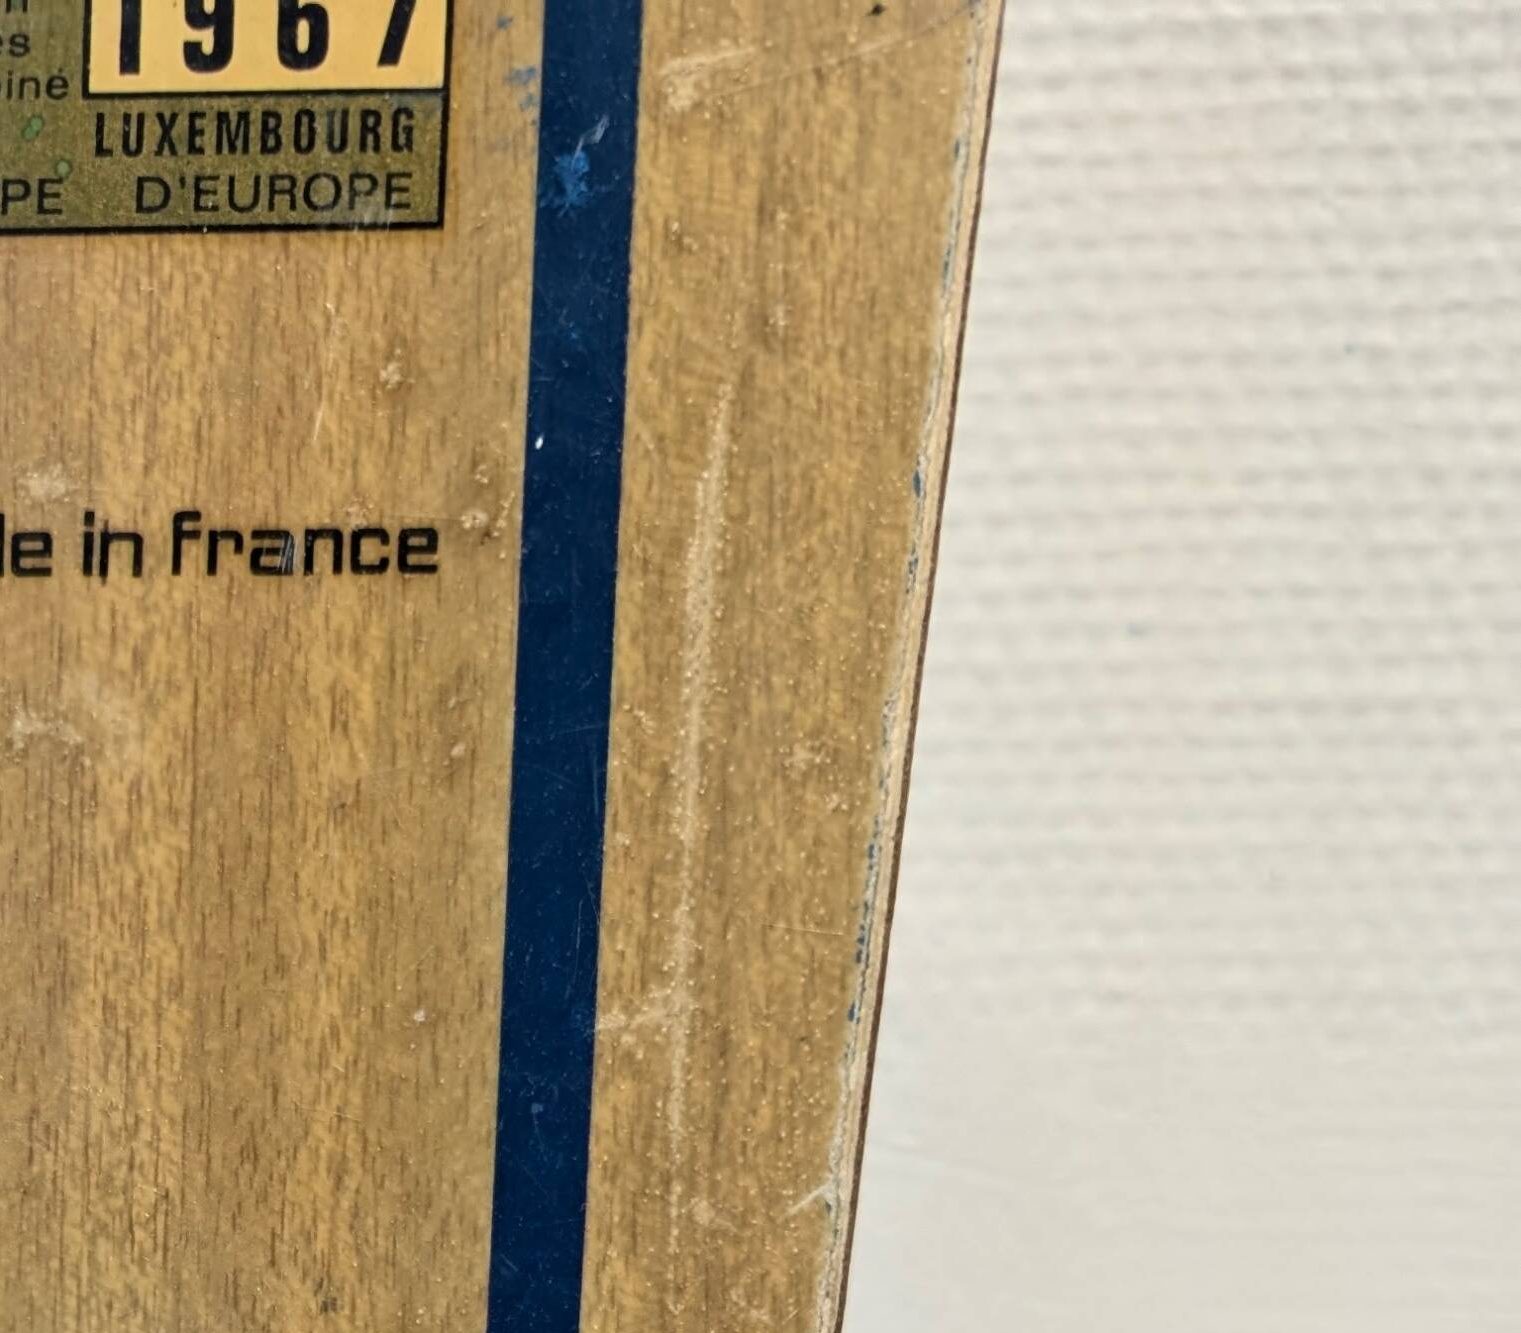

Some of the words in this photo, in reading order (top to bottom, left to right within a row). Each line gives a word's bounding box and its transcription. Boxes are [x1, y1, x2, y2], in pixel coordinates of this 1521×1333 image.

[119, 0, 418, 76] 1967
[94, 107, 415, 158] LUXEMBOURG
[134, 172, 412, 214] D'EUROPE
[83, 511, 143, 580] in
[172, 510, 439, 577] france
